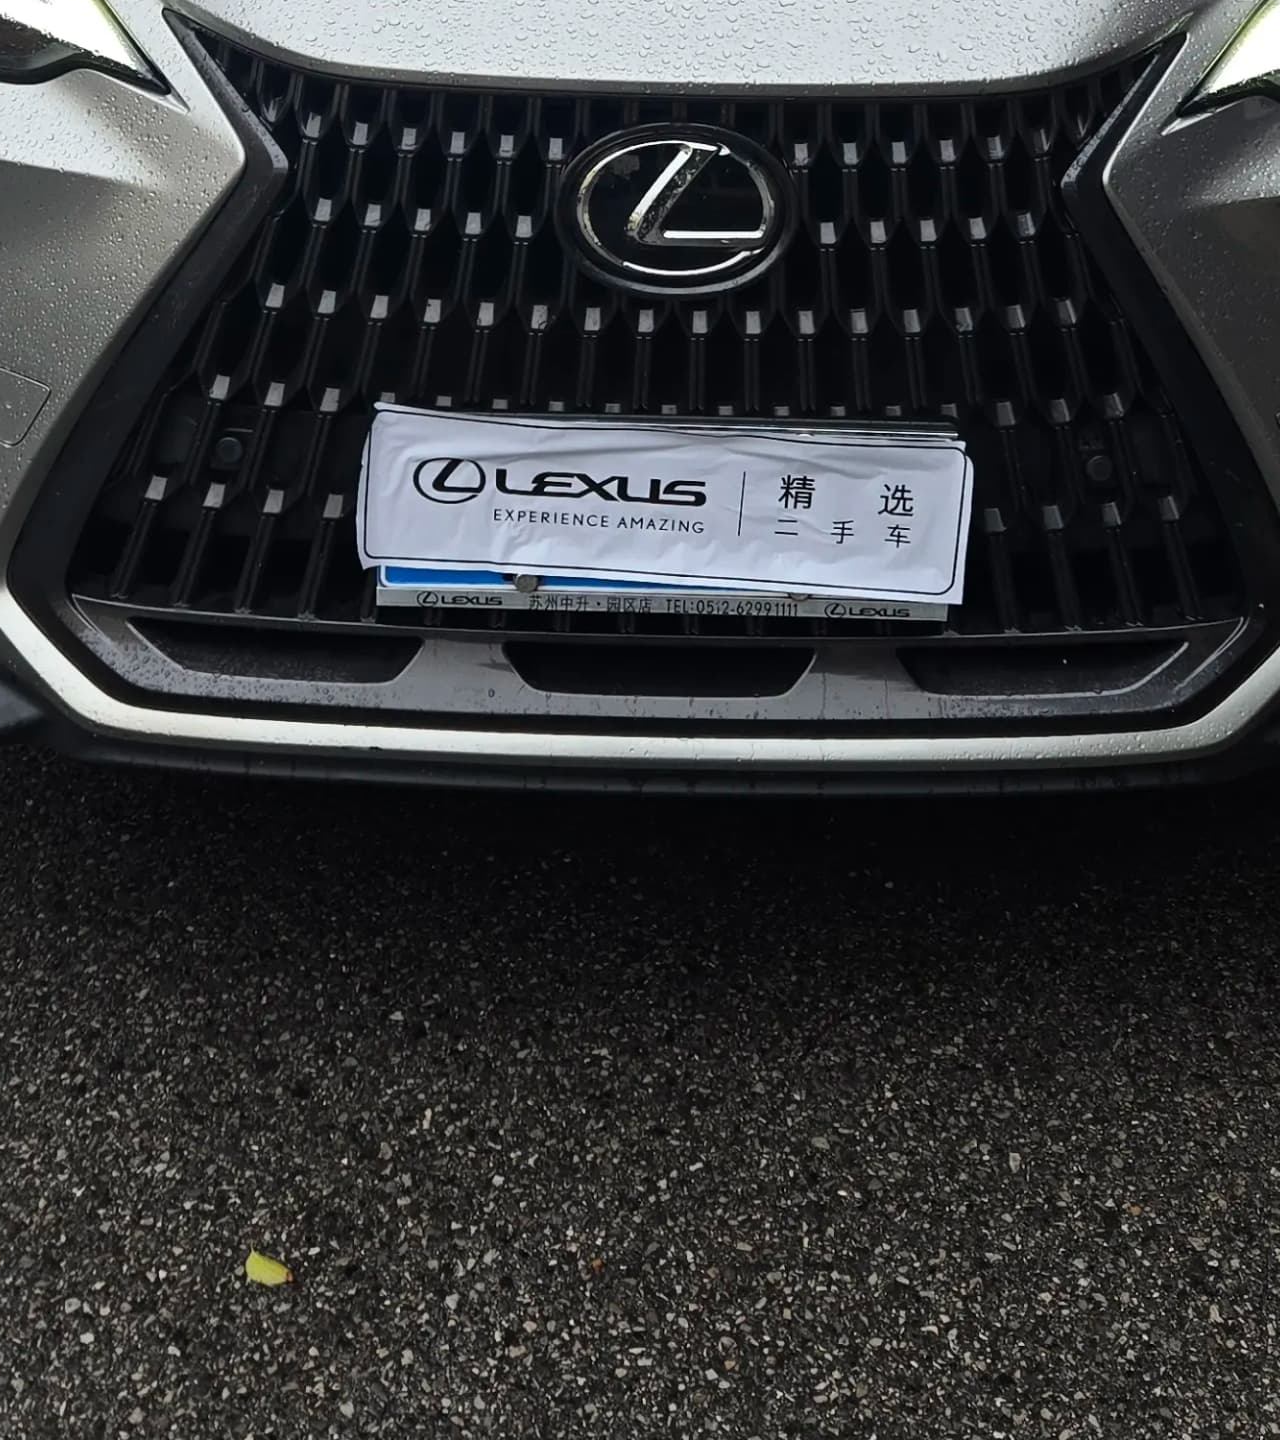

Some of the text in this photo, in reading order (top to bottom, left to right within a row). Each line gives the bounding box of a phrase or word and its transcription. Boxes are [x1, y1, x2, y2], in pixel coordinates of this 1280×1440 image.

[495, 468, 707, 507] LEXUS
[493, 508, 705, 534] EXPERIENCE AMAZING
[774, 519, 912, 549] 二手车
[440, 595, 503, 607] LEXUS
[848, 607, 911, 618] LEXUS
